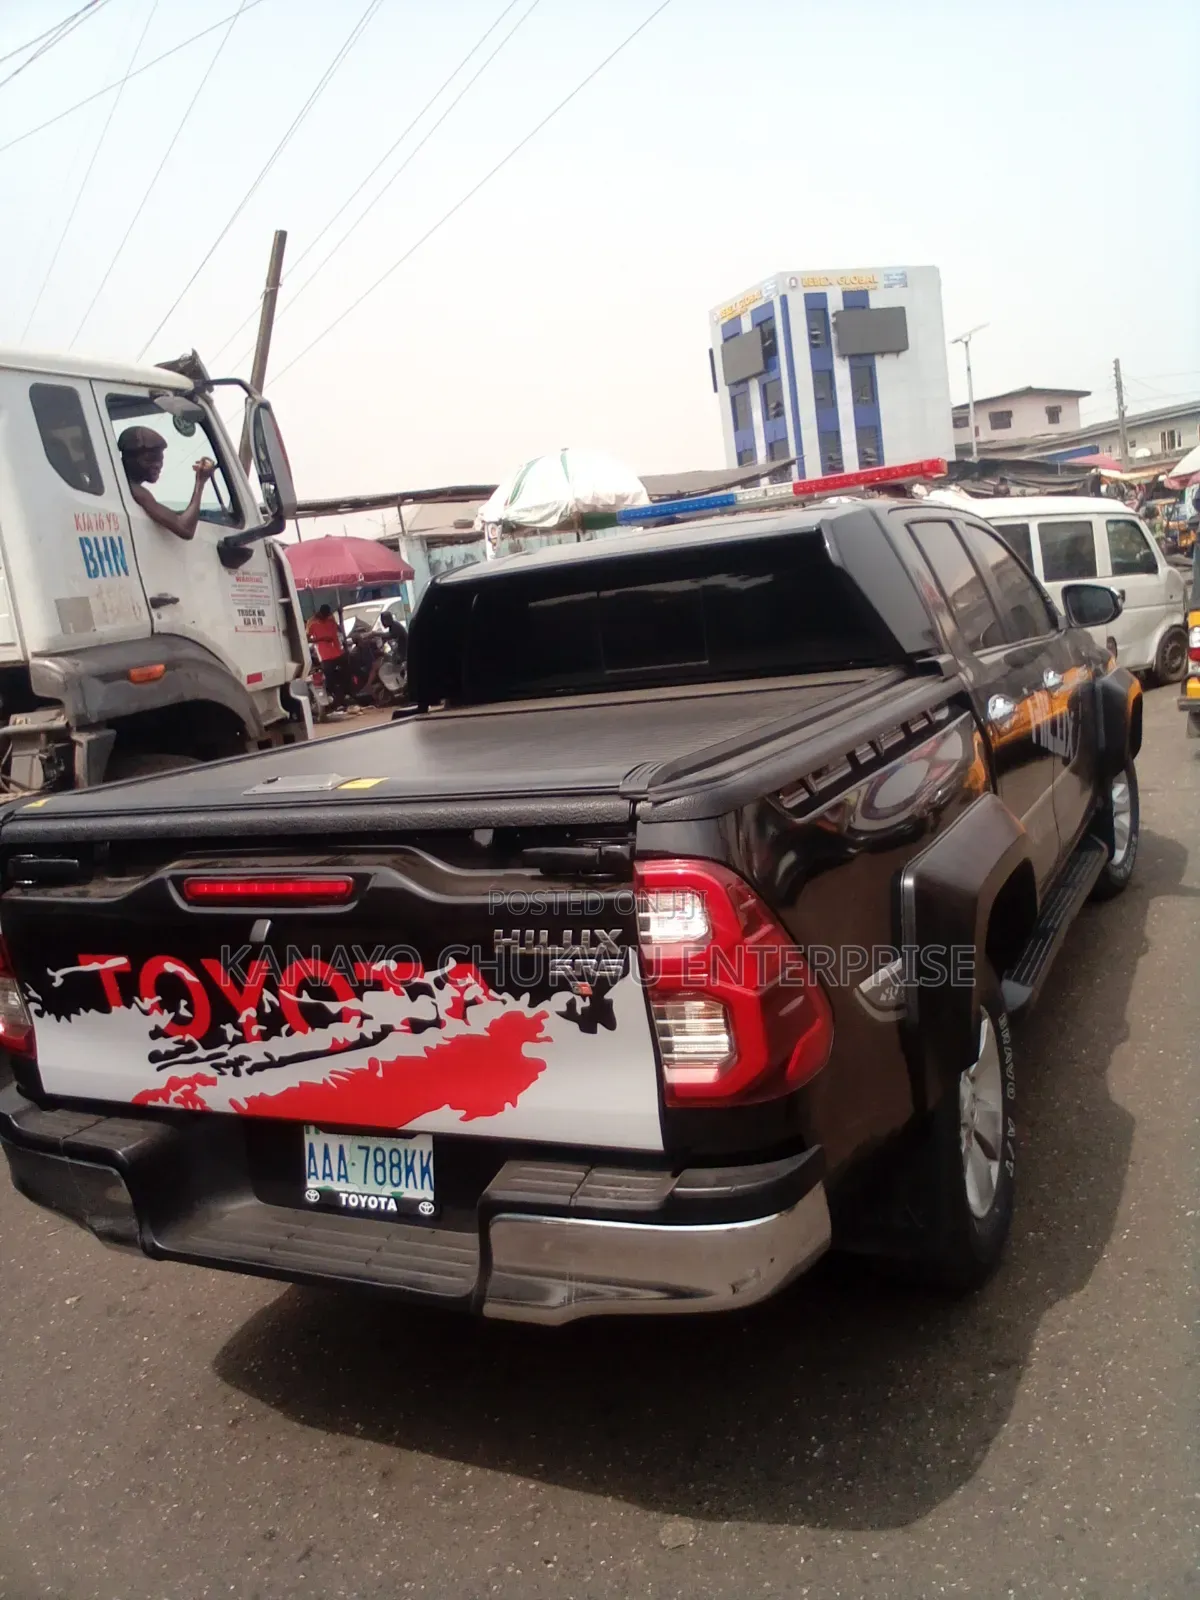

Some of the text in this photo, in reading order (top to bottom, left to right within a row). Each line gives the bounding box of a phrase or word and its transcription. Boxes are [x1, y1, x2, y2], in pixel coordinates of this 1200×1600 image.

[78, 536, 130, 579] BHN
[493, 928, 624, 955] HILUX
[999, 1012, 1016, 1101] BRAVO
[340, 1192, 398, 1212] TOYOTA
